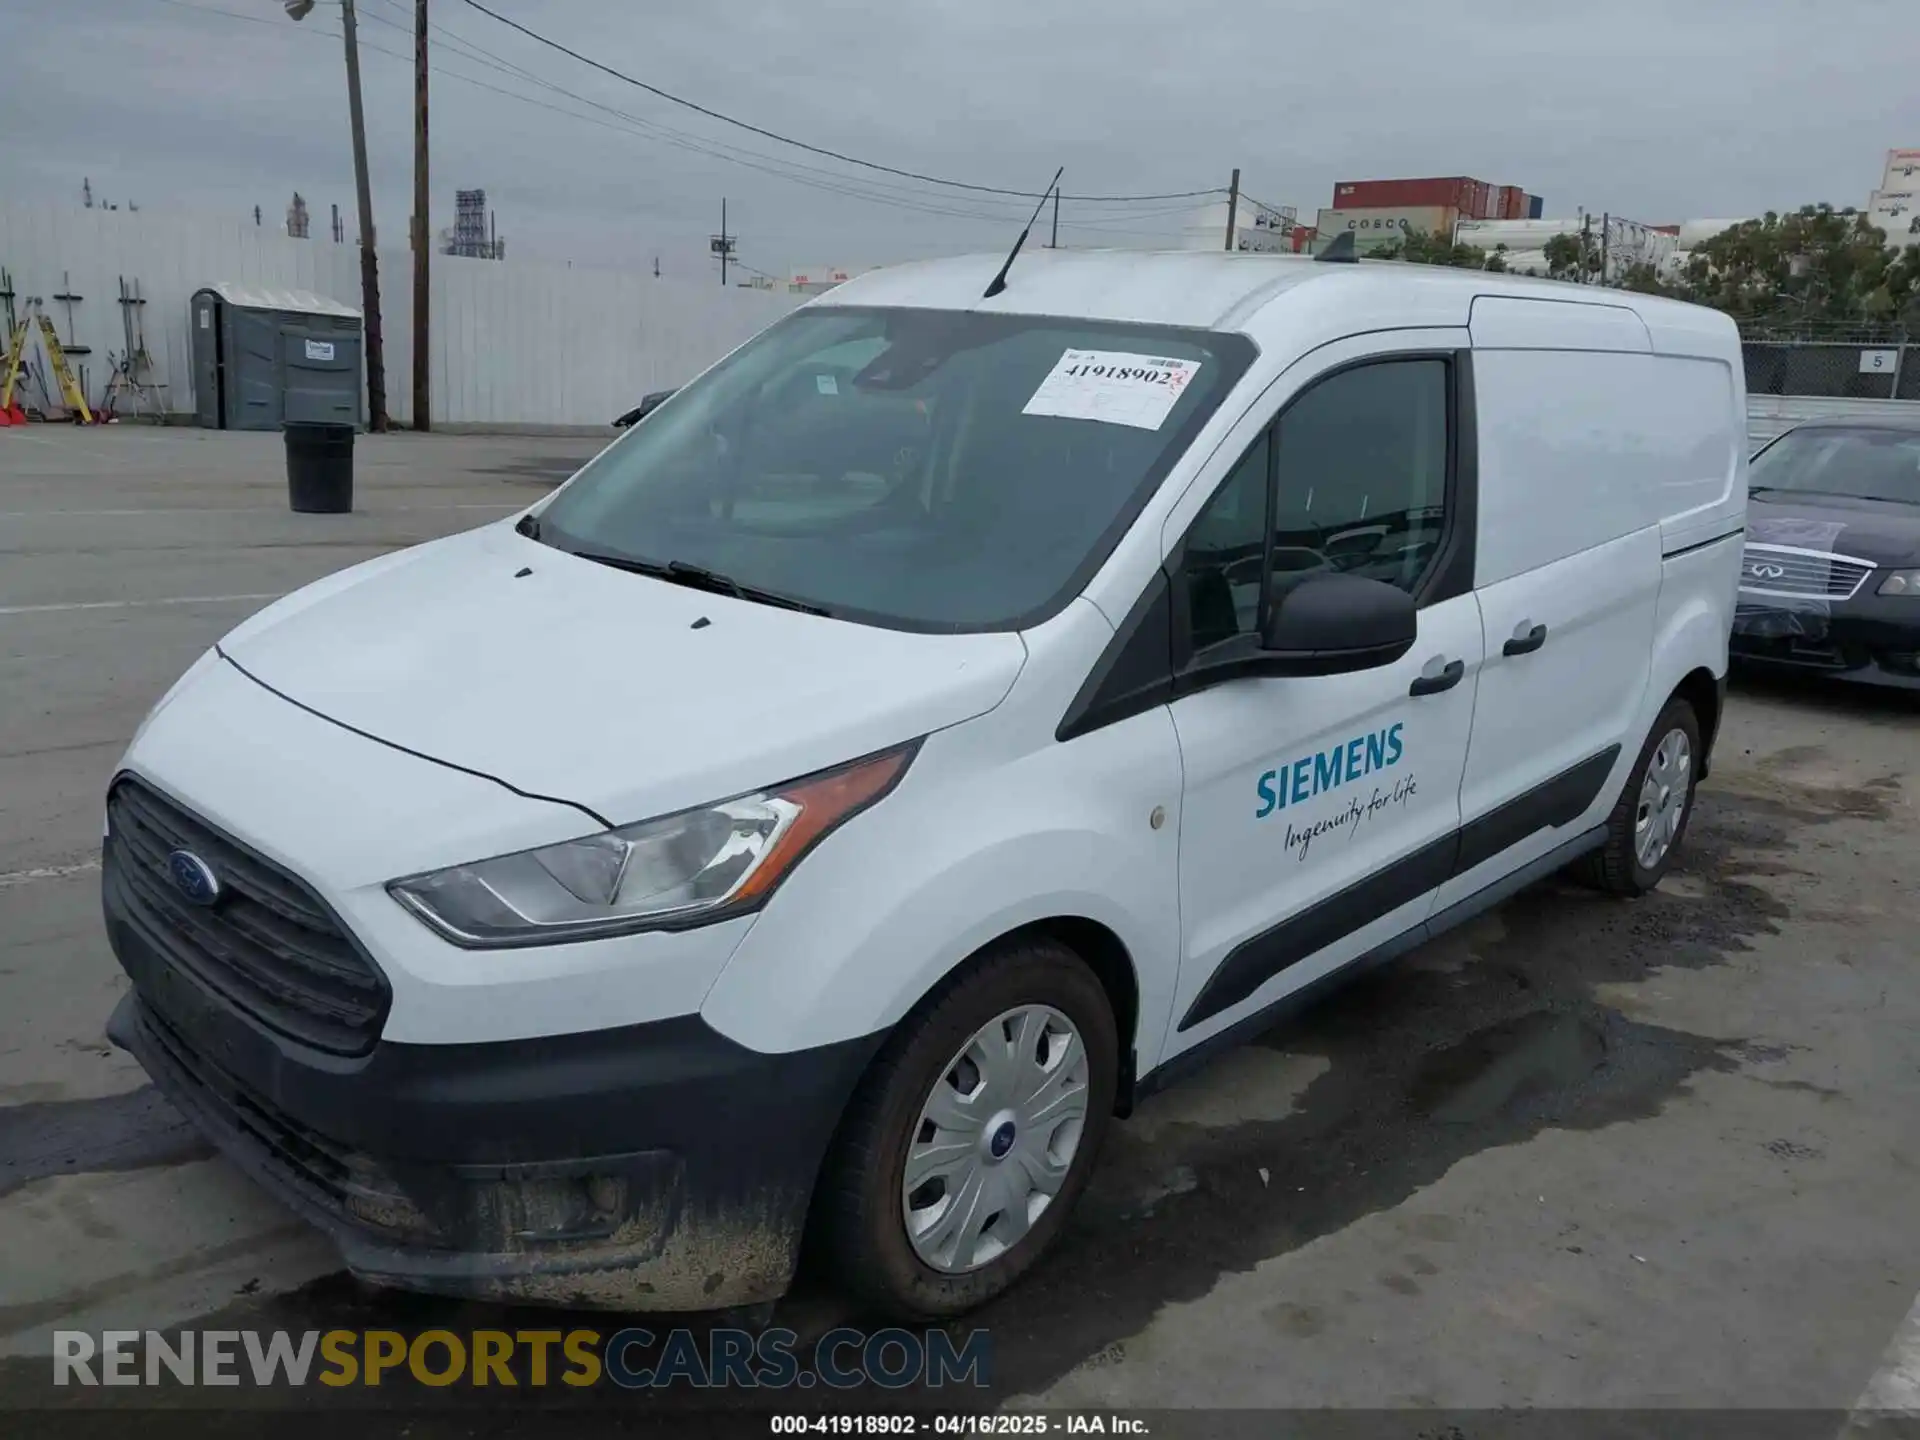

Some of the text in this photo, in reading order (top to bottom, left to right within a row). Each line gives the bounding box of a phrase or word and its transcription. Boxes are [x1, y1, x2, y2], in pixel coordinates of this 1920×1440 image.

[1064, 363, 1172, 385] 41918902
[1873, 355, 1883, 368] 5
[1255, 721, 1404, 819] SIEMENS
[1283, 773, 1417, 862] Ingenuity for life
